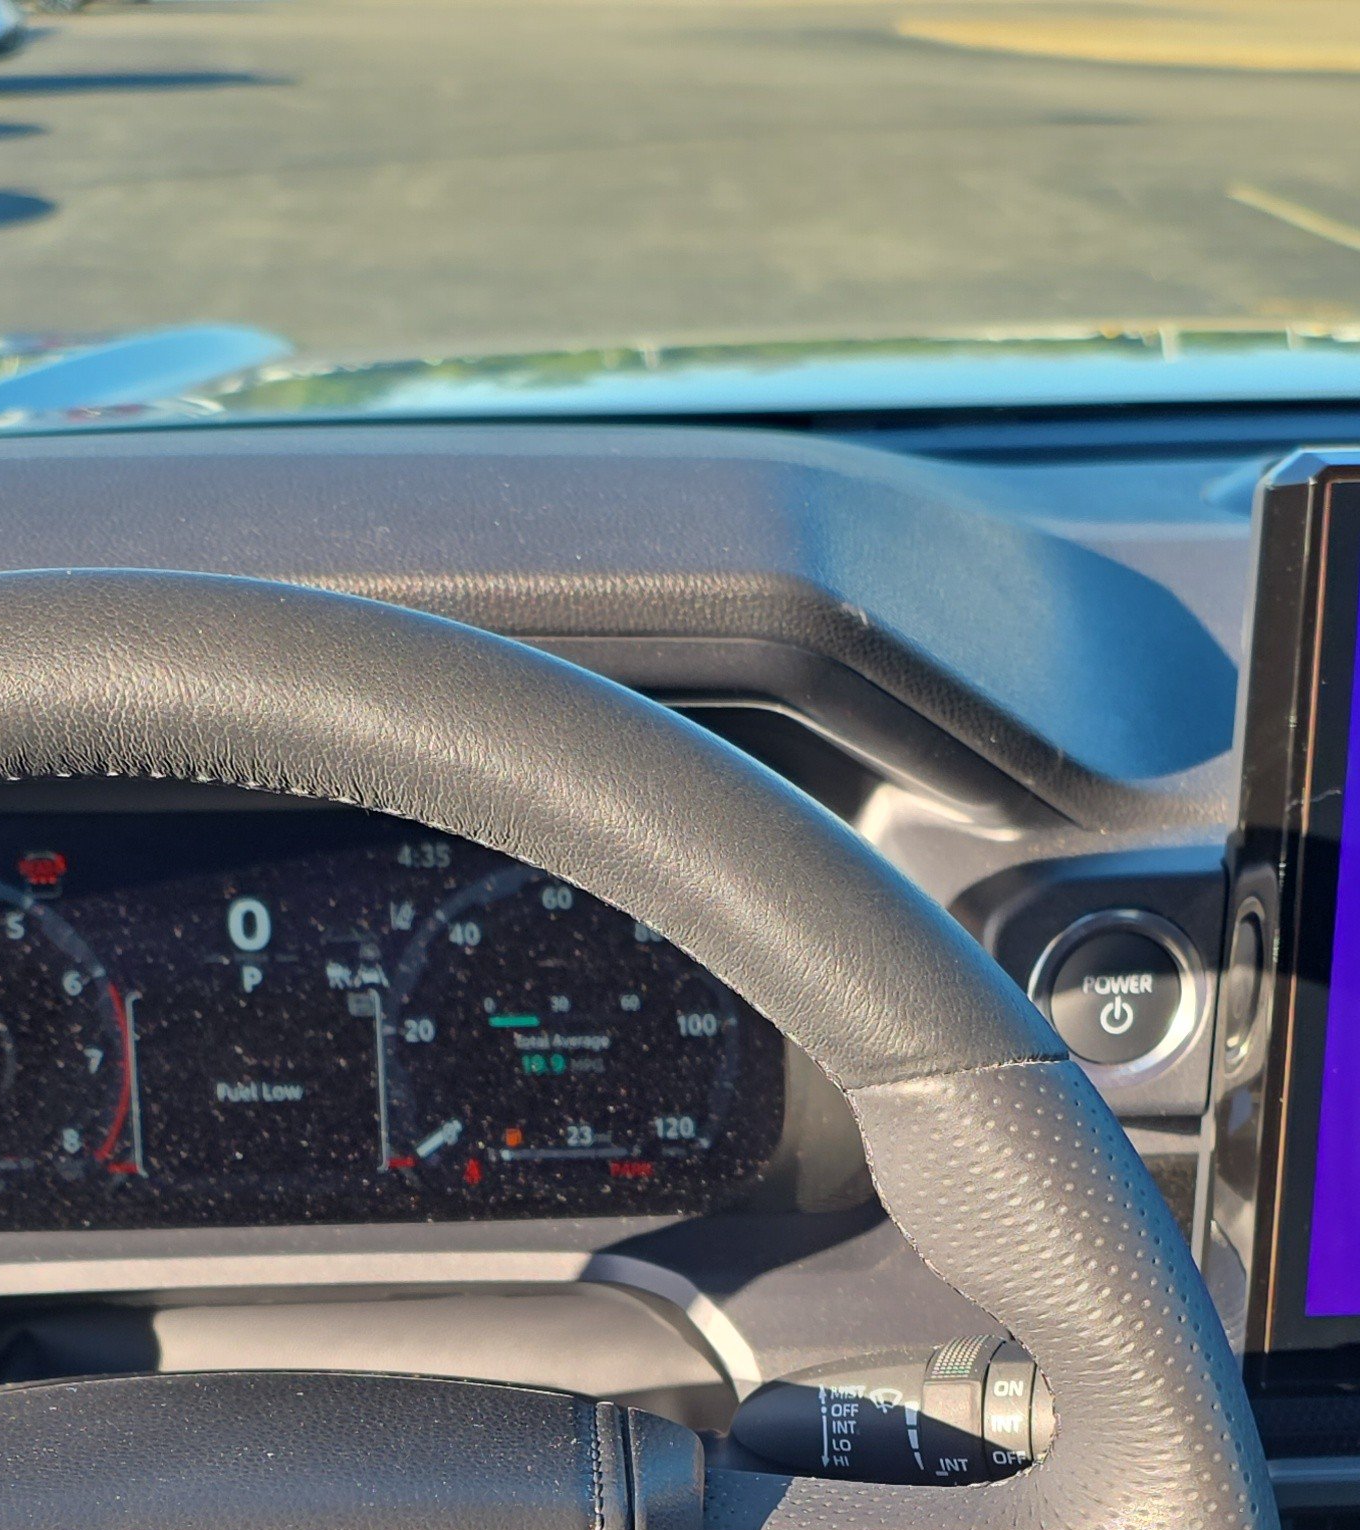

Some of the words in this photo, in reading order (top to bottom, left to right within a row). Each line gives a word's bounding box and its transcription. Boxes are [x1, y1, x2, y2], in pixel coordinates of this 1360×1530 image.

[398, 844, 451, 868] 4:35
[542, 887, 572, 910] 60
[6, 916, 24, 939] 5
[229, 899, 271, 951] 0
[449, 921, 481, 946] 40
[63, 971, 83, 996] 6
[243, 966, 262, 993] P
[1083, 975, 1152, 994] POWER
[403, 1019, 436, 1043] 20
[677, 1013, 717, 1037] 100
[553, 1033, 610, 1050] Average
[85, 1046, 104, 1074] 7
[217, 1082, 258, 1101] Fuel
[262, 1082, 303, 1101] Low
[567, 1125, 592, 1146] 23
[655, 1116, 695, 1139] 120
[994, 1381, 1023, 1396] ON
[831, 1404, 858, 1417] OFF
[833, 1421, 856, 1434] INT
[991, 1415, 1022, 1433] INT
[833, 1439, 851, 1452] LO
[833, 1456, 849, 1466] HI
[940, 1458, 968, 1471] INT
[993, 1451, 1025, 1464] OFF
